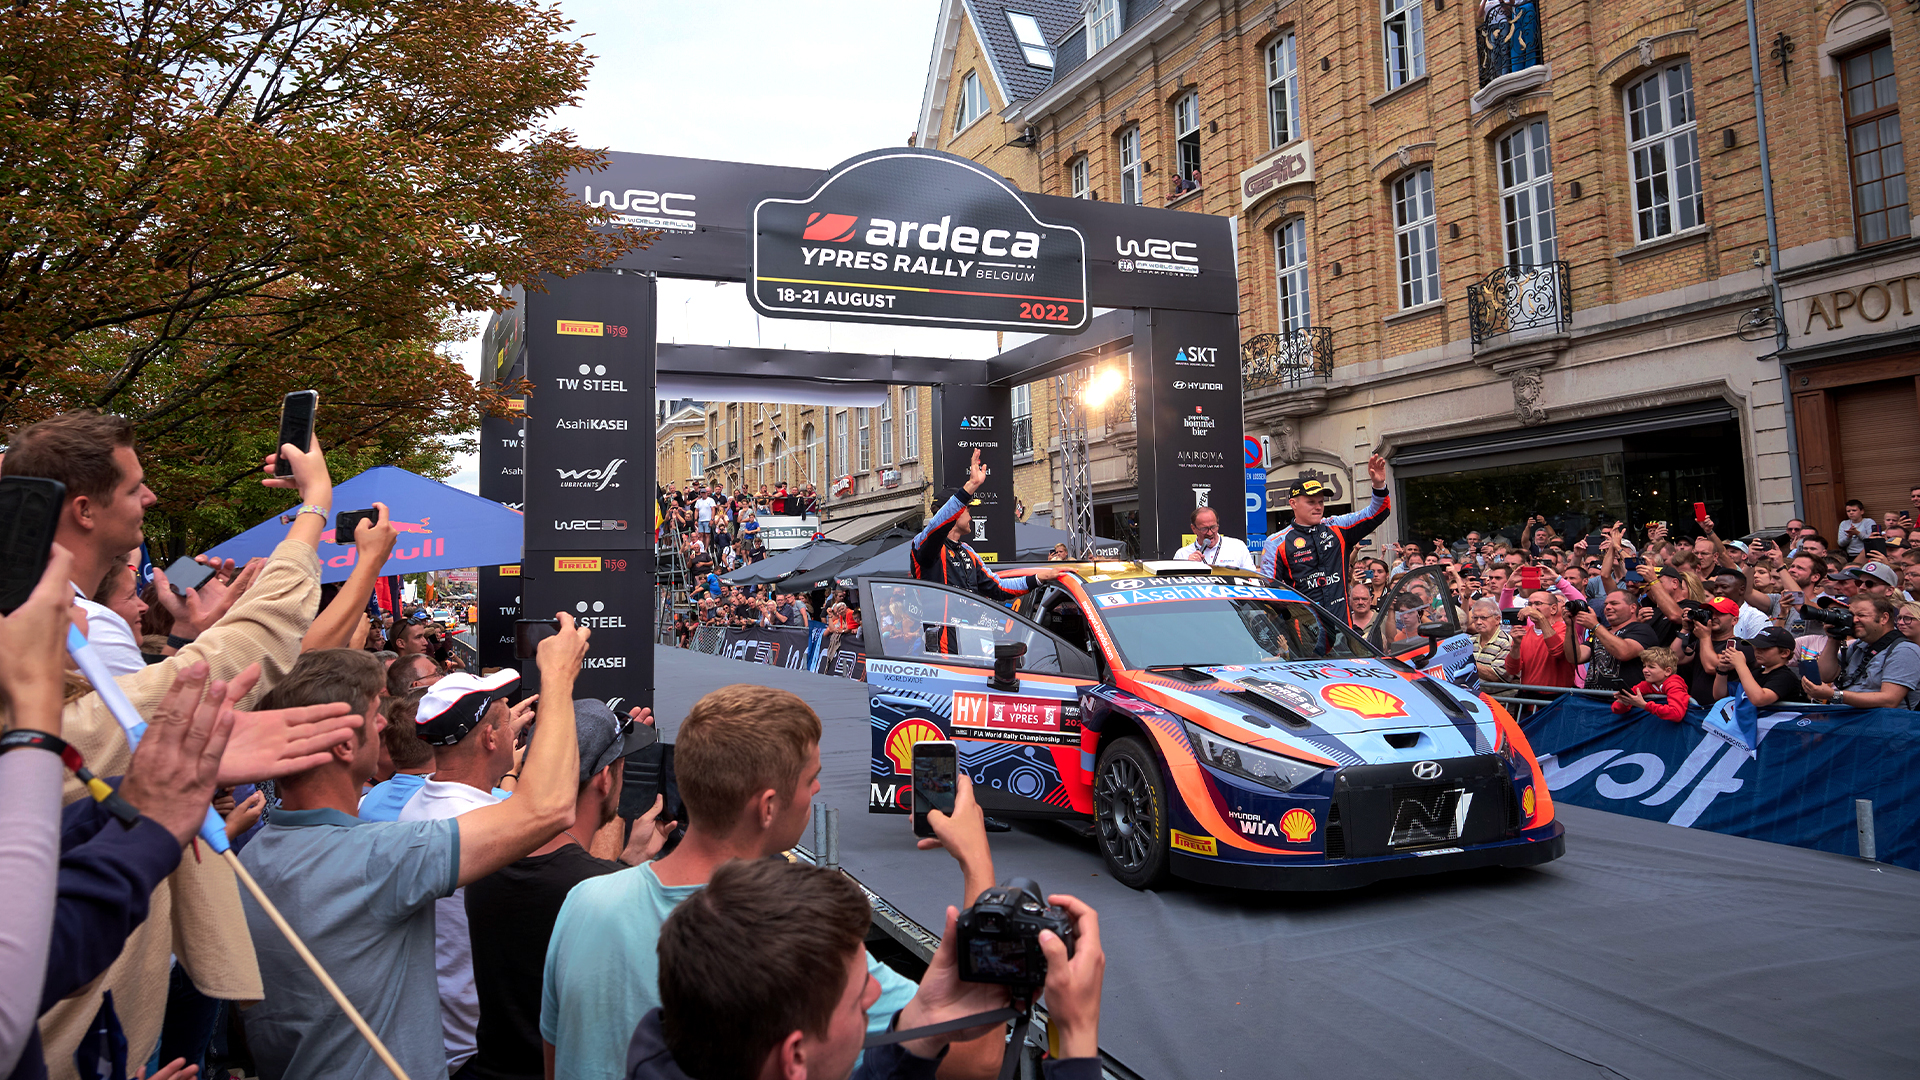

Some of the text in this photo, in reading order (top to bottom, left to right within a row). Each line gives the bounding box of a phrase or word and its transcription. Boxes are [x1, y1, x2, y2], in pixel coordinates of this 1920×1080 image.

[585, 185, 696, 217] WRC
[865, 215, 1040, 259] ardeca
[1116, 235, 1198, 262] WRC
[801, 246, 1035, 282] YPRES RALLY BELGIUM
[776, 287, 896, 309] 18-21 AUGUST
[1804, 274, 1920, 335] APOT
[1019, 302, 1069, 321] 2022
[561, 323, 599, 333] PIRELLI
[1188, 346, 1218, 363] SKT
[556, 378, 628, 392] TW STEEL
[1188, 382, 1223, 390] HYUNDAI
[556, 418, 628, 430] AsahiKASEI
[970, 415, 995, 427] SKT
[1183, 417, 1215, 428] hommel
[1192, 427, 1208, 436] bier
[501, 439, 518, 448] TW
[556, 459, 625, 491] wolf
[757, 528, 814, 538] eshalles
[388, 537, 444, 560] ull
[558, 560, 597, 569] PIRELLI
[1148, 576, 1227, 586] HYUNDAI
[1307, 572, 1340, 589] MOBIS
[1108, 595, 1118, 604] 8
[1132, 585, 1279, 603] AsahiKASEI
[499, 607, 516, 615] TW
[581, 616, 626, 628] STEEL
[1081, 601, 1114, 661] motorsport.hyundai.com
[580, 657, 626, 668] iKASEI
[1250, 662, 1336, 673] HYUNDAI
[870, 663, 939, 677] INNOCEAN
[1289, 667, 1398, 681] MOBIS
[884, 674, 923, 684] WORLDWIDE
[956, 696, 982, 722] HY
[1013, 702, 1036, 714] VISIT
[1009, 713, 1039, 724] YPRES
[1065, 718, 1081, 727] 202
[1003, 732, 1018, 741] Rally
[1019, 734, 1060, 743] Championship
[1228, 811, 1261, 821] HYUNDAI
[1175, 833, 1211, 852] PIRELLI
